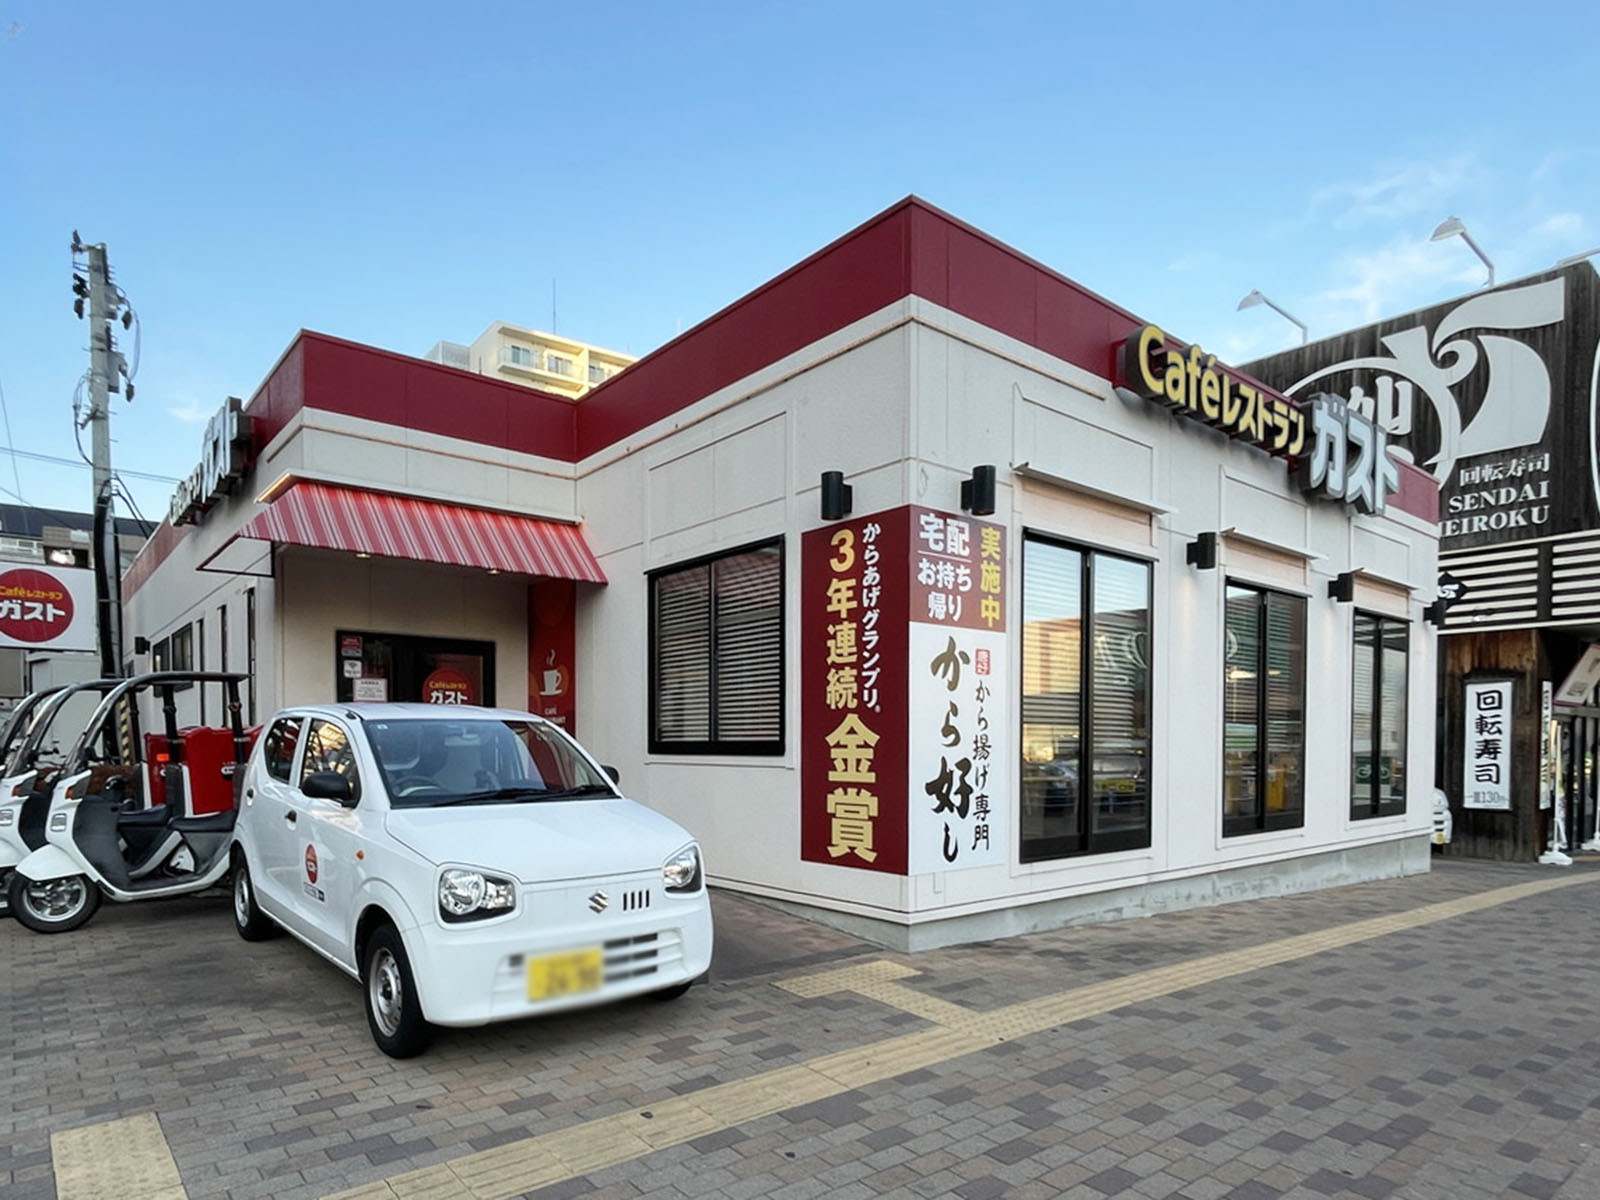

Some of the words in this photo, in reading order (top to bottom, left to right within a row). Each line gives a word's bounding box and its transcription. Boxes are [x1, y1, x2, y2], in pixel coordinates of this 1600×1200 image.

[1138, 324, 1306, 456] Caféレストラン
[1309, 395, 1399, 514] ガスト
[1459, 452, 1550, 487] 回転寿司
[1448, 480, 1550, 514] SENDAI
[919, 513, 970, 557] 宅配
[1439, 504, 1551, 538] EIROKU
[917, 557, 973, 592] お持ち
[979, 526, 1001, 628] 実施中
[0, 599, 66, 623] ガスト
[928, 591, 962, 622] 帰り
[430, 689, 469, 704] ガスト
[825, 529, 881, 864] 3年連続金賞
[925, 635, 974, 863] から好し
[1474, 690, 1503, 785] 回転寿司
[972, 679, 992, 851] から揚げ専門
